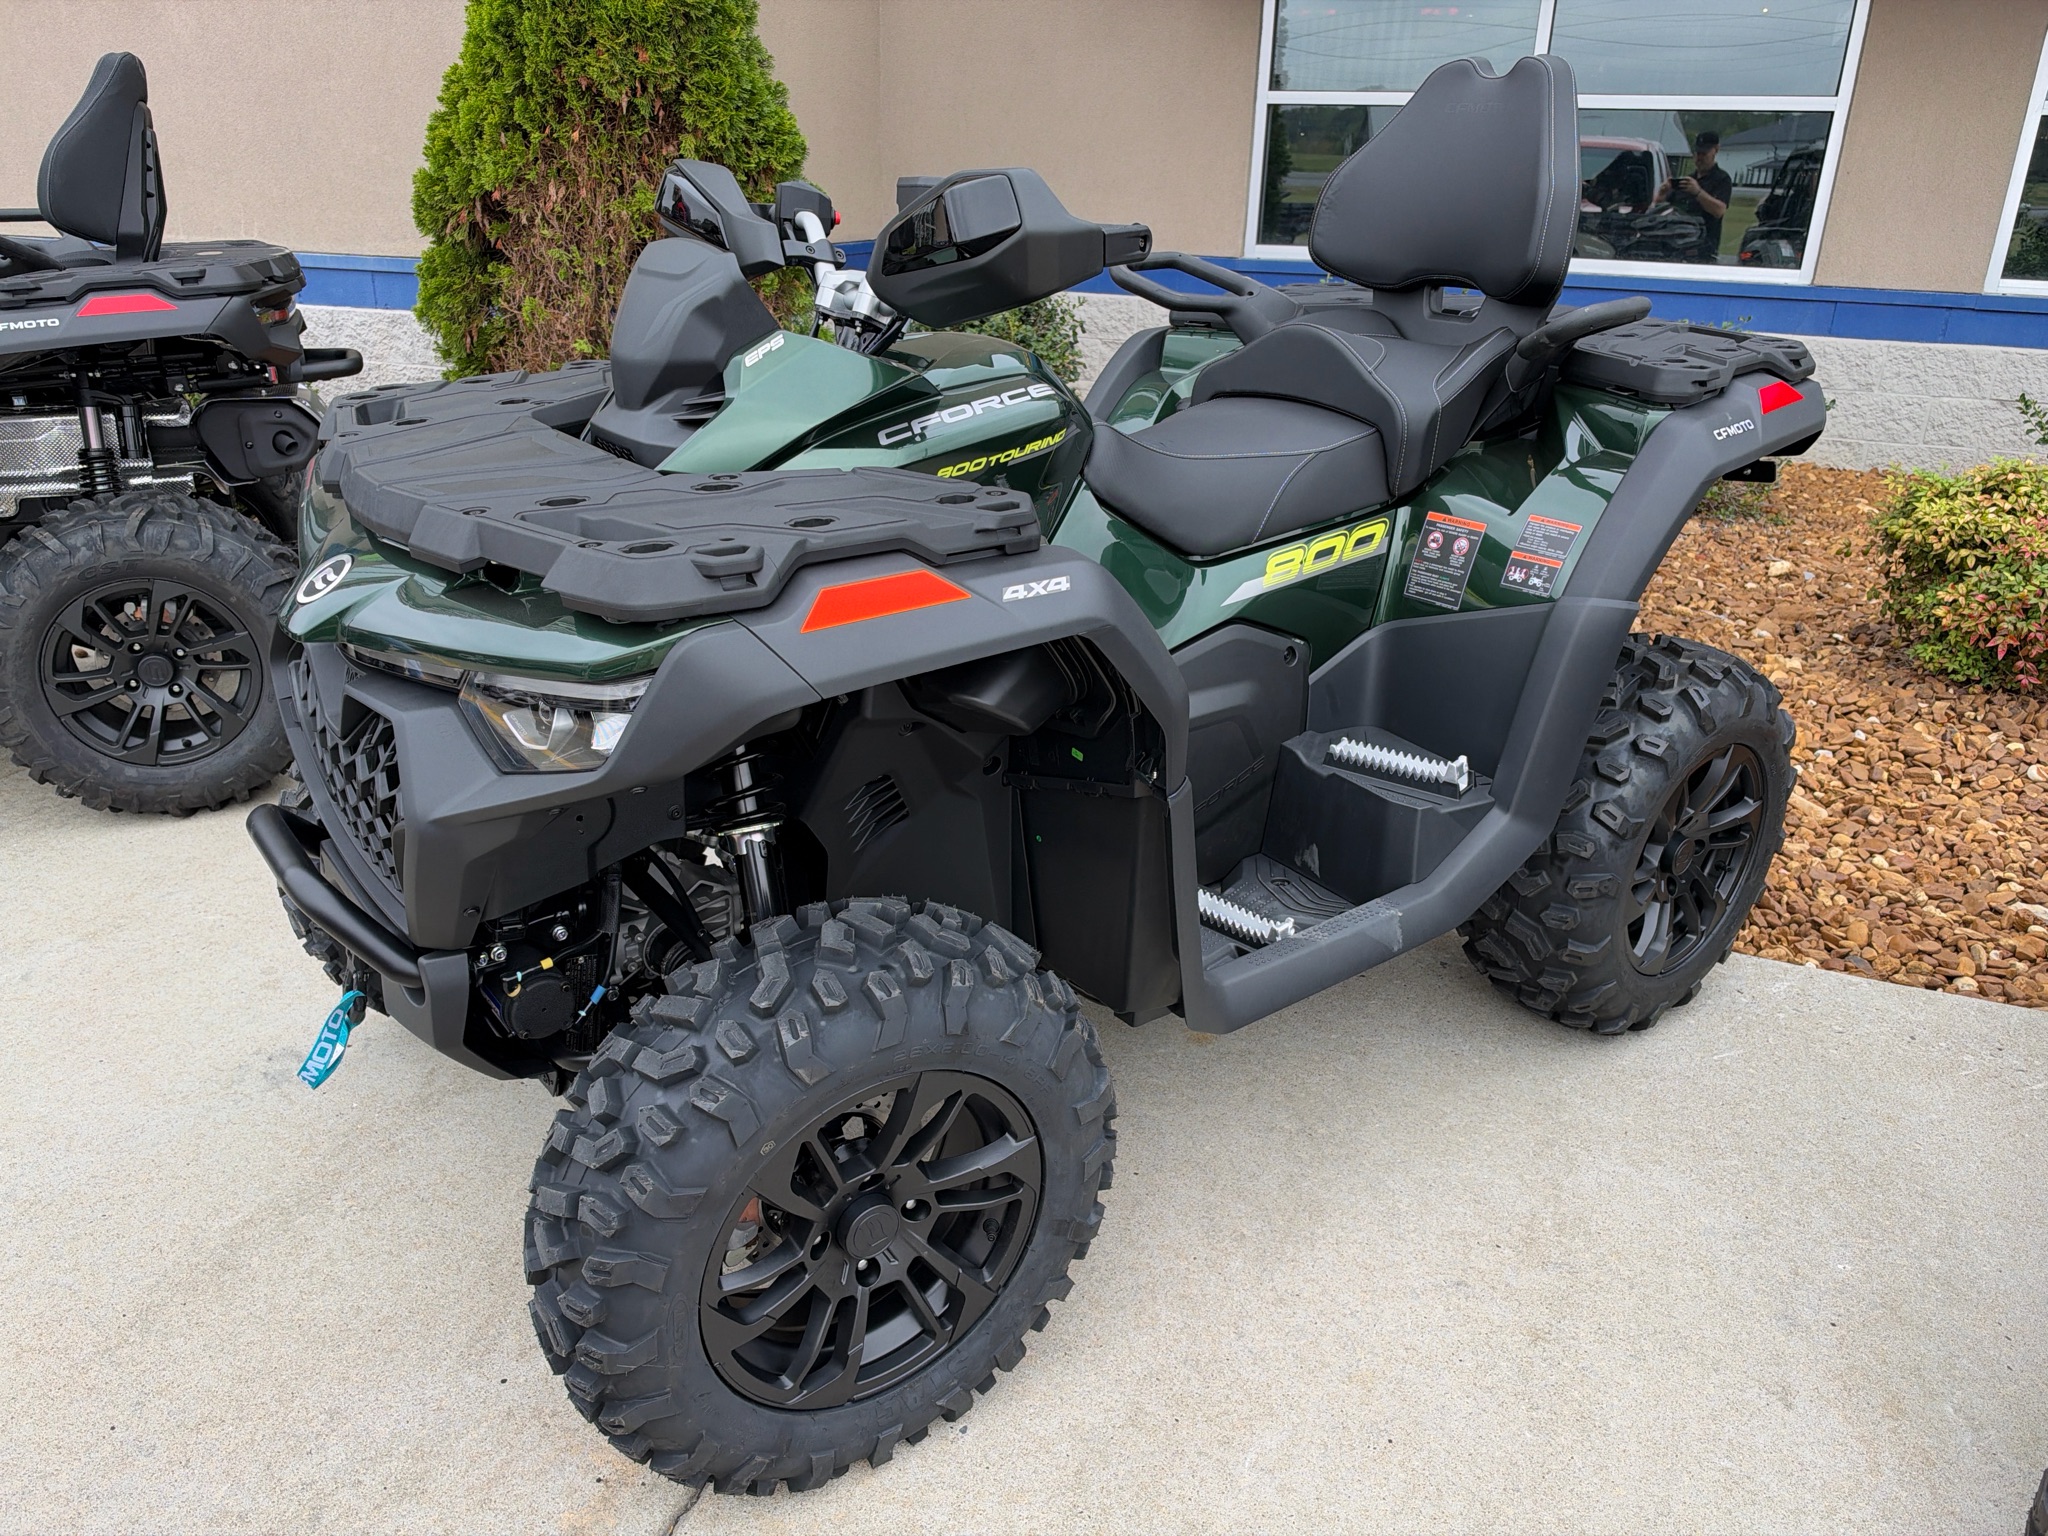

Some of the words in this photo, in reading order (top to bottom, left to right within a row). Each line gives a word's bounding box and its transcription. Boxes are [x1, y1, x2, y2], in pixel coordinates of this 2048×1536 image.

[744, 333, 785, 368] EPS
[877, 383, 1056, 446] CFORCE
[1713, 418, 1755, 441] CFMOTO
[988, 428, 1067, 467] TOURING
[1448, 518, 1471, 527] WARNING
[1262, 517, 1390, 589] 800
